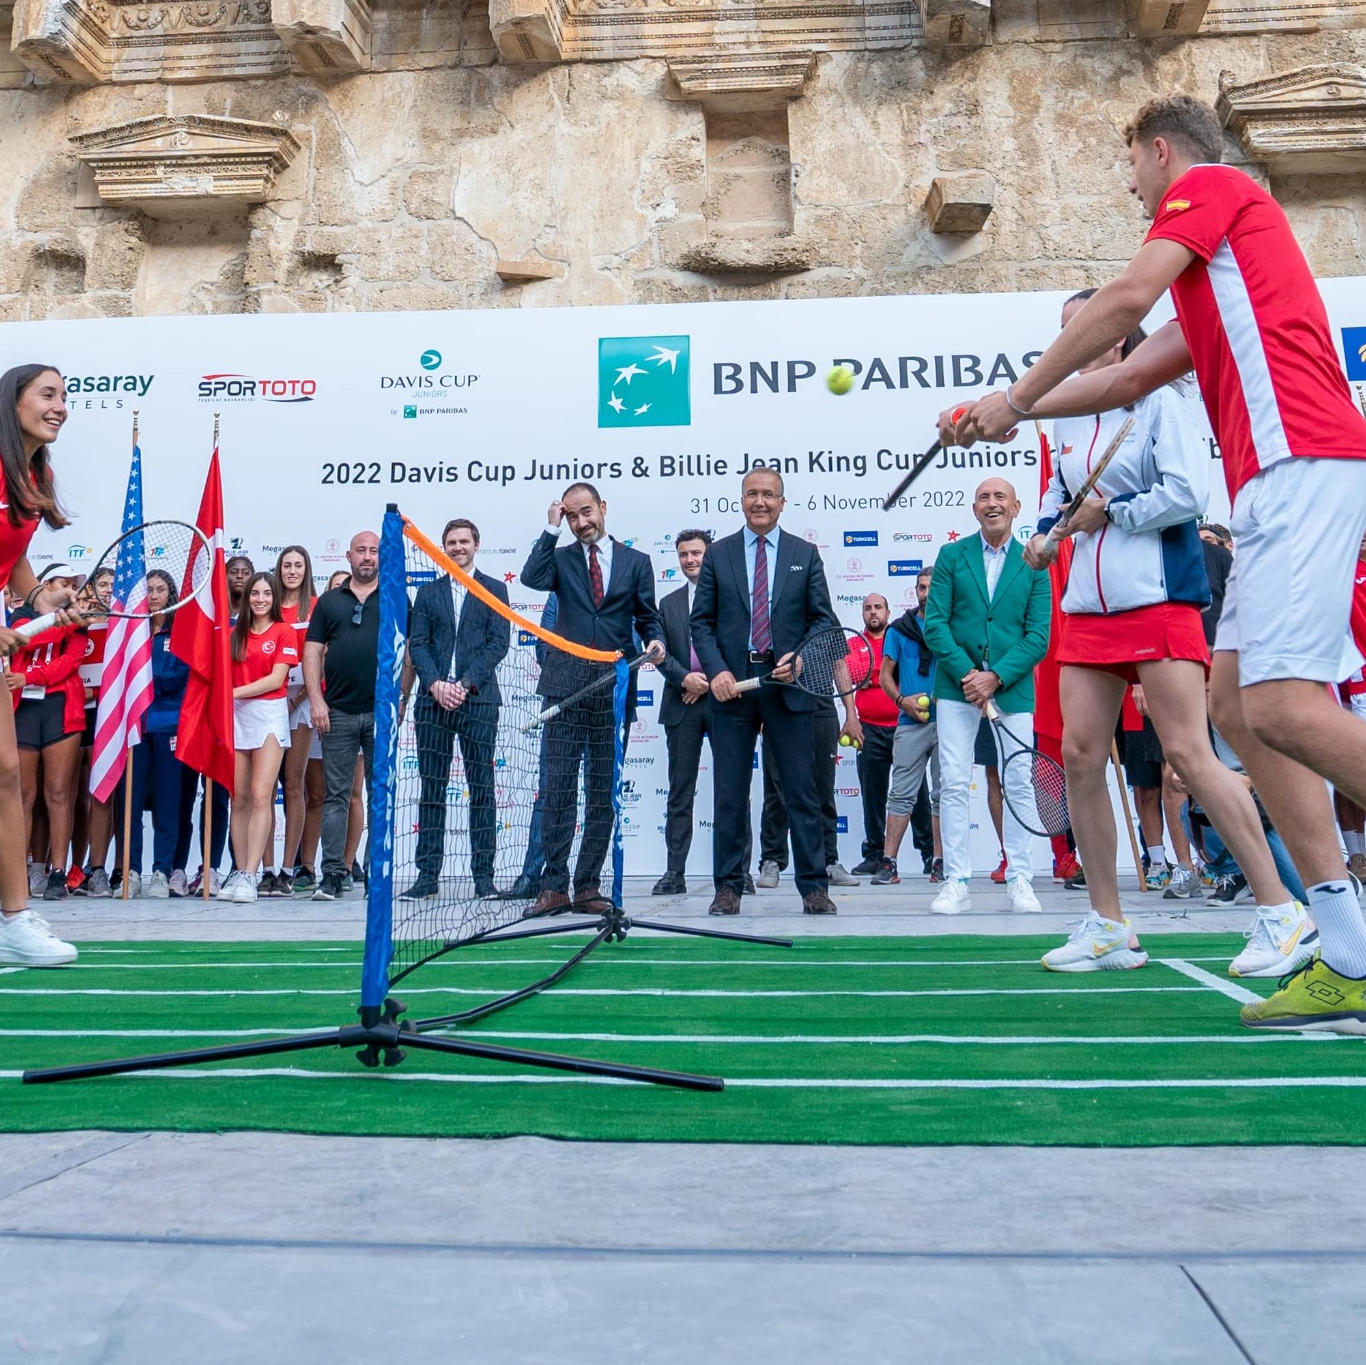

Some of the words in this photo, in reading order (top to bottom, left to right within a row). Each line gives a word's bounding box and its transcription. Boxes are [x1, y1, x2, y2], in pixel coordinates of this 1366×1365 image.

[381, 375, 433, 388] DAVIS
[440, 375, 478, 387] CUP
[713, 360, 816, 395] BNP
[63, 374, 155, 397] asaray
[412, 390, 448, 398] JUNIORS
[69, 399, 124, 410] TELS
[321, 462, 381, 484] 2022
[390, 461, 458, 484] Davis
[467, 460, 516, 486] Cup
[524, 457, 623, 481] Juniors
[632, 456, 650, 478] &
[659, 452, 728, 477] Billie
[737, 450, 799, 475] Jean
[808, 450, 868, 477] King
[935, 445, 1038, 469] Juniors
[690, 498, 709, 513] 31
[807, 495, 817, 511] 6
[923, 490, 965, 508] 2022
[69, 549, 86, 557] ITF
[837, 595, 866, 603] Megasa
[624, 756, 655, 765] gasaray
